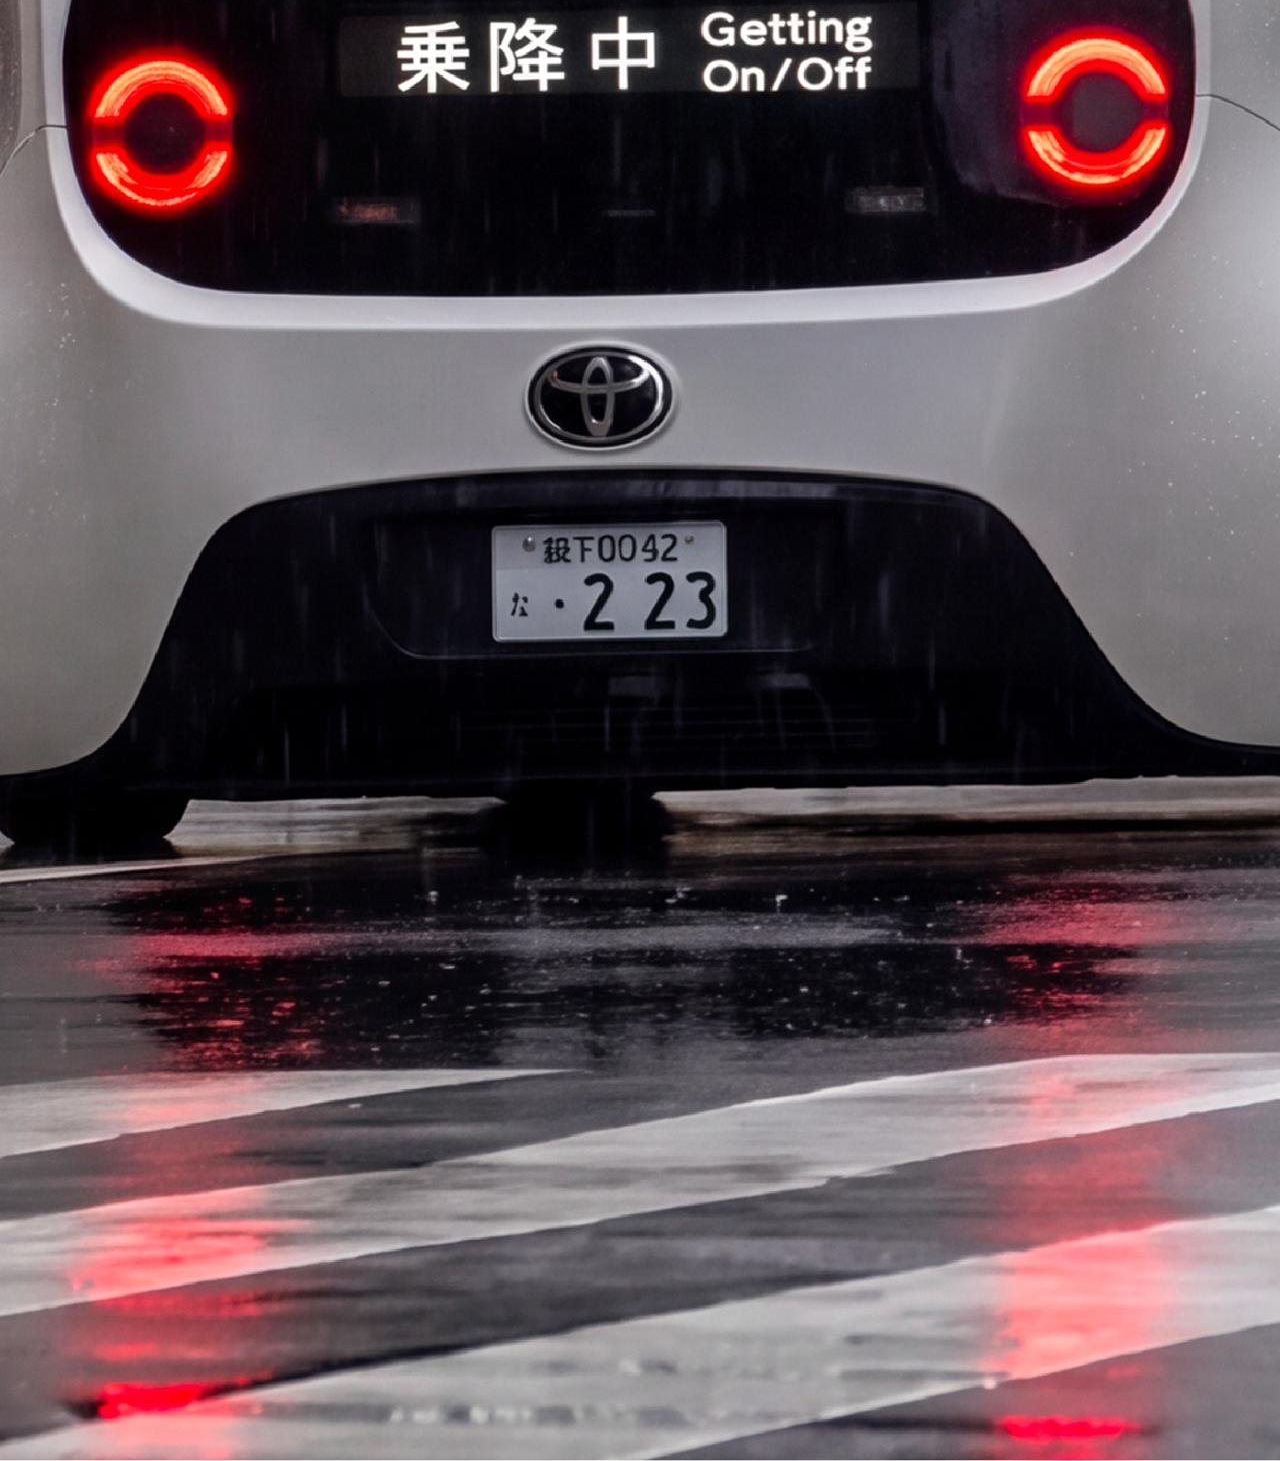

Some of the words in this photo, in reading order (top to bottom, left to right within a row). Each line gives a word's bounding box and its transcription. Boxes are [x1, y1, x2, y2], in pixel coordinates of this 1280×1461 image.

[700, 9, 874, 54] Getting
[396, 15, 657, 94] 乗降中
[702, 55, 873, 93] On/Off
